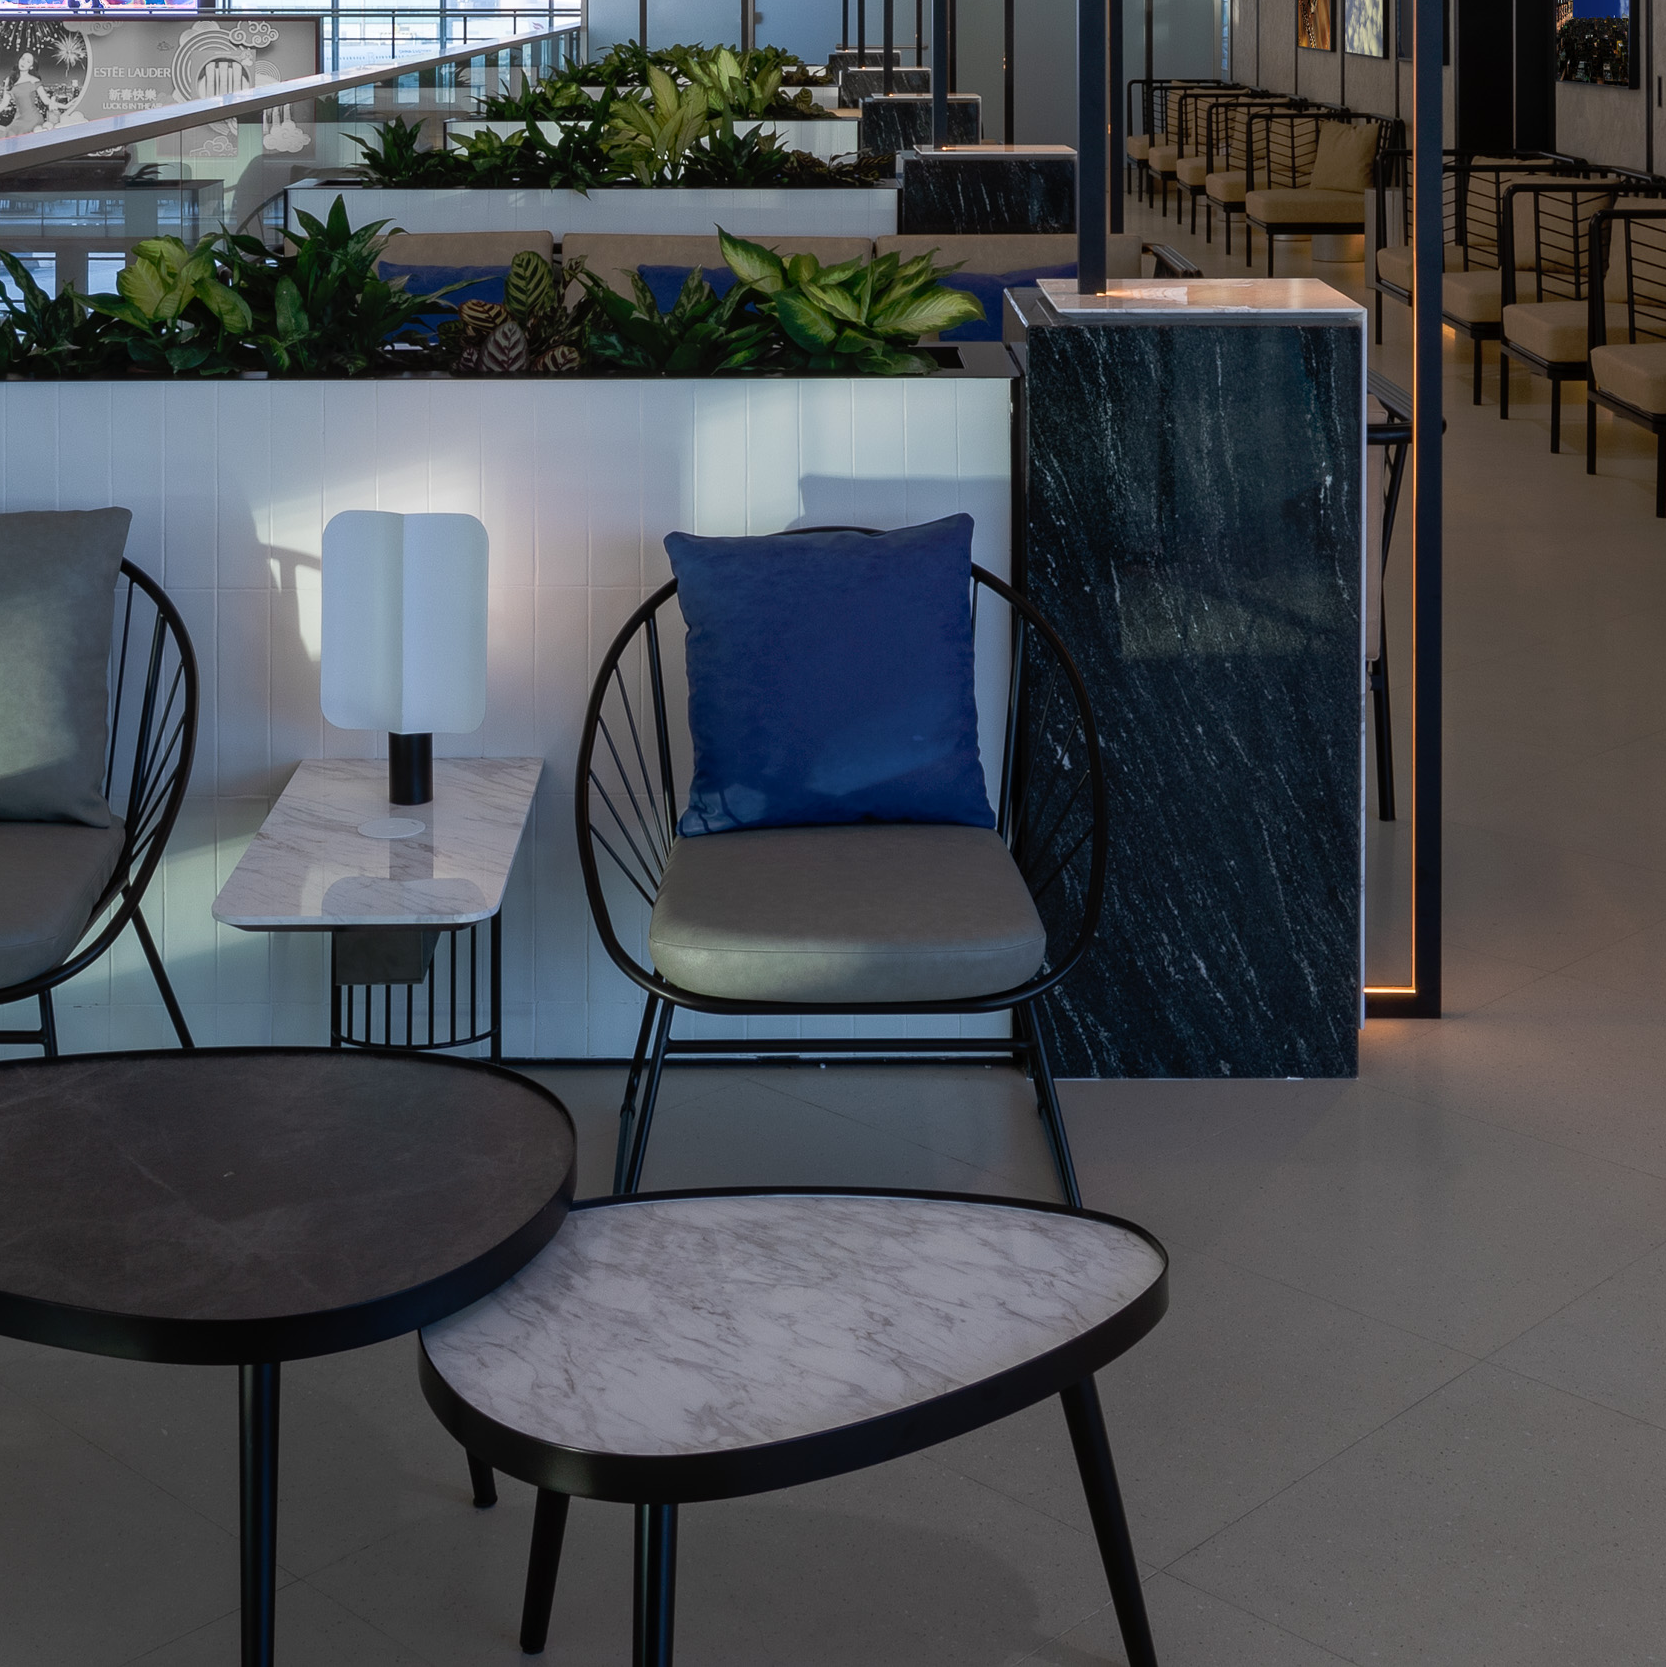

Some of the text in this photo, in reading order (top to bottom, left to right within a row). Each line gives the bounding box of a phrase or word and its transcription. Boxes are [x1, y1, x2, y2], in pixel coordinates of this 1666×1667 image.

[128, 67, 171, 78] LAUDER
[109, 88, 157, 101] 新春快樂
